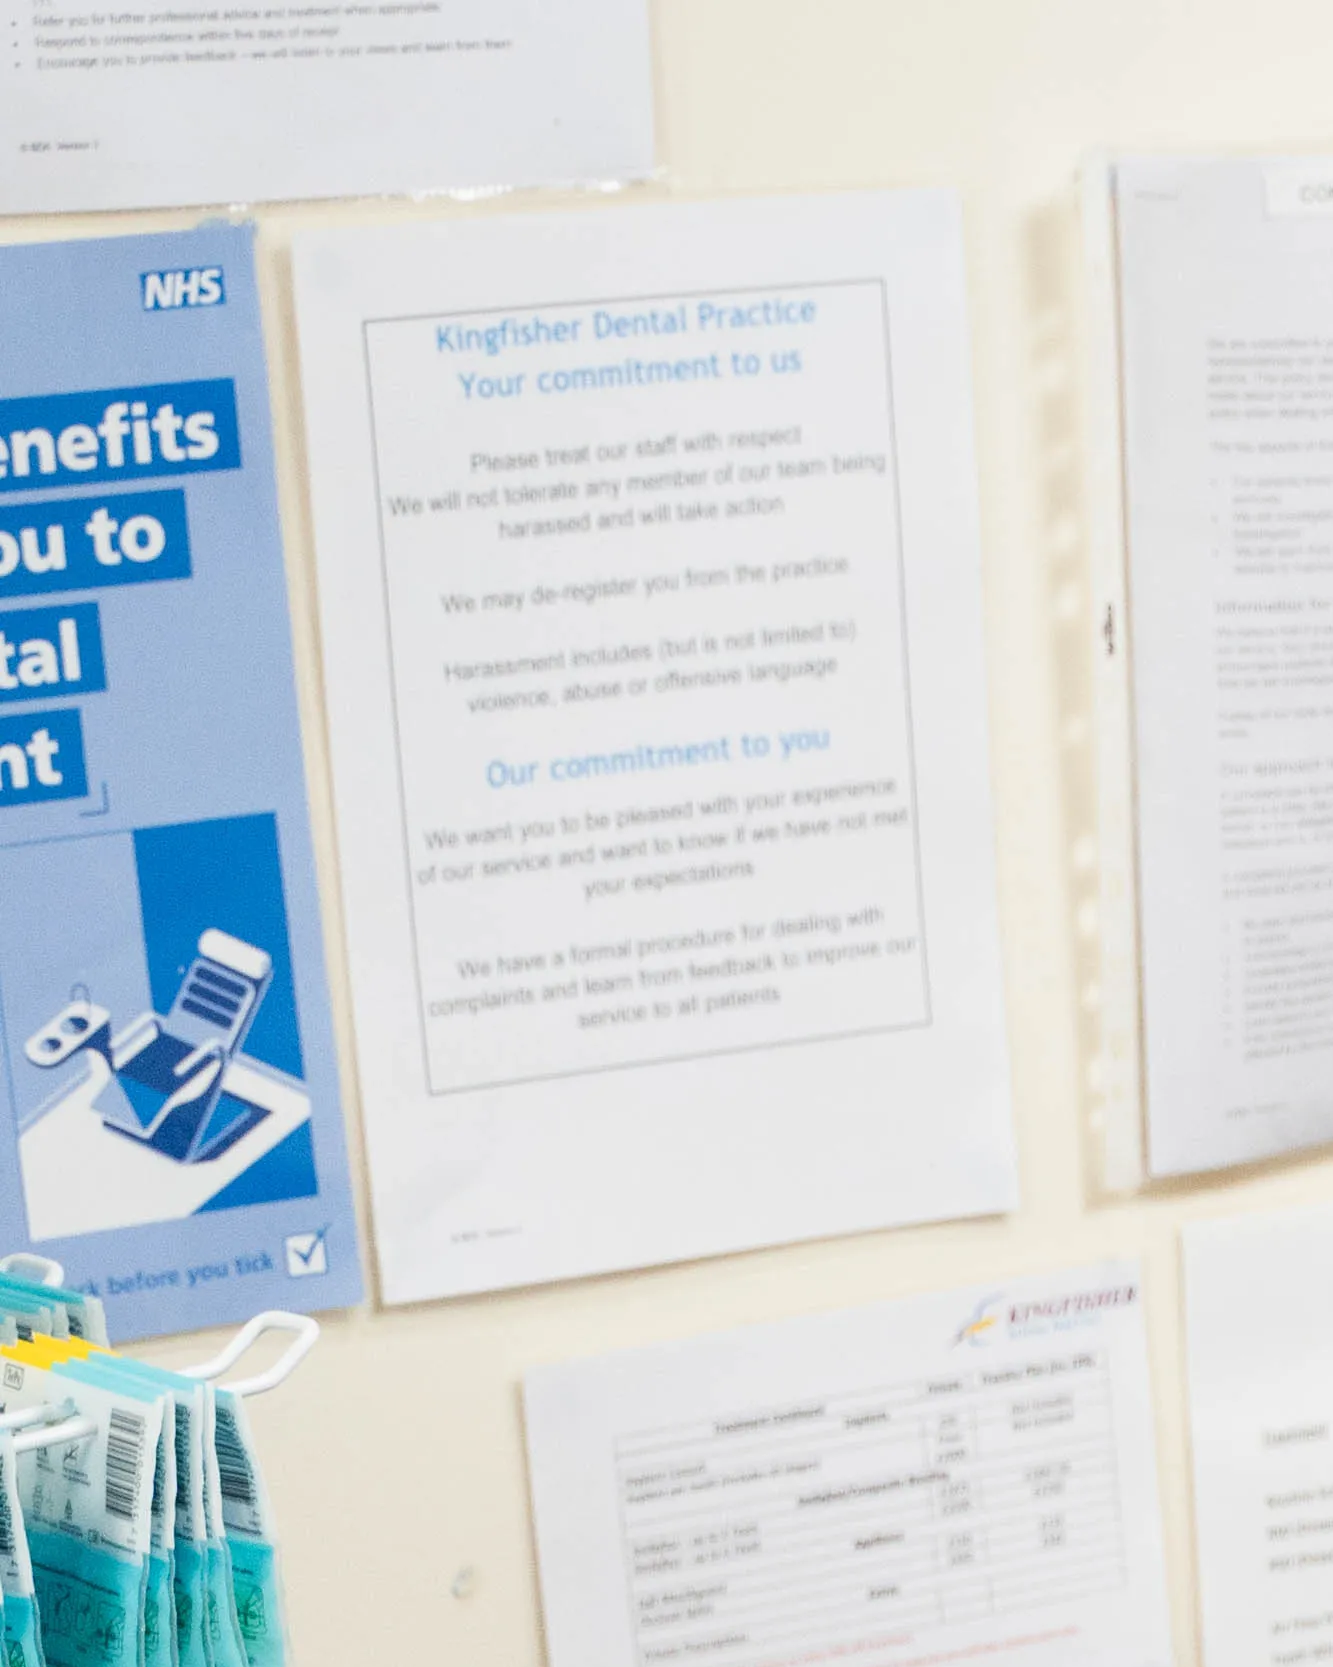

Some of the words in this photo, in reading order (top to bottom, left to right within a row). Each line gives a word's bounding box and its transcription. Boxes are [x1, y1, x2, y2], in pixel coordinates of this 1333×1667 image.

[144, 269, 221, 310] NHS
[435, 317, 582, 357] Kingfisher
[592, 305, 688, 340] Dental
[696, 301, 816, 330] Practice
[457, 371, 526, 400] Your
[536, 353, 722, 394] commitment
[730, 352, 761, 376] to
[770, 350, 802, 373] us
[0, 401, 219, 479] nefits
[469, 452, 540, 473] Please
[544, 445, 590, 467] treat
[596, 443, 628, 462] our
[635, 434, 677, 458] staff
[682, 432, 722, 453] with
[729, 426, 802, 449] respect
[428, 490, 462, 513] will
[466, 488, 499, 508] not
[503, 481, 579, 505] tolerate
[585, 479, 621, 499] any
[626, 470, 708, 491] member
[739, 465, 771, 482] our
[777, 460, 826, 477] team
[832, 456, 886, 474] being
[86, 507, 165, 566] to
[497, 512, 592, 540] harassed
[596, 508, 634, 530] and
[639, 503, 672, 525] will
[676, 501, 719, 522] take
[725, 497, 784, 518] action
[481, 592, 525, 612] may
[530, 578, 637, 606] de-register
[643, 576, 680, 598] you
[684, 568, 730, 587] from
[734, 564, 766, 584] the
[771, 558, 849, 584] practice
[486, 759, 539, 789] Our
[549, 736, 730, 781] commitment
[740, 734, 771, 758] to
[778, 731, 830, 759] you
[464, 822, 513, 846] want
[519, 821, 555, 843] you
[616, 801, 694, 829] pleased
[699, 795, 738, 816] with
[745, 793, 786, 814] your
[791, 780, 896, 806] experience
[441, 864, 474, 882] our
[481, 854, 552, 877] service
[558, 845, 596, 867] and
[600, 839, 648, 861] want
[677, 832, 728, 851] know
[784, 819, 831, 838] have
[838, 812, 867, 830] not
[873, 808, 908, 825] met
[583, 878, 626, 903] your
[630, 861, 755, 892] expectations
[496, 954, 546, 974] have
[569, 939, 632, 964] formal
[637, 929, 736, 959] procedure
[740, 924, 765, 941] for
[773, 915, 842, 938] dealing
[846, 906, 884, 927] with
[428, 987, 535, 1018] complaints
[541, 980, 578, 1002] and
[583, 976, 633, 995] learn
[638, 968, 684, 987] from
[687, 954, 775, 980] feedback
[806, 942, 880, 966] improve
[887, 938, 916, 953] our
[577, 1005, 647, 1030] service
[678, 994, 699, 1016] all
[705, 986, 781, 1014] patients
[186, 1262, 228, 1287] you
